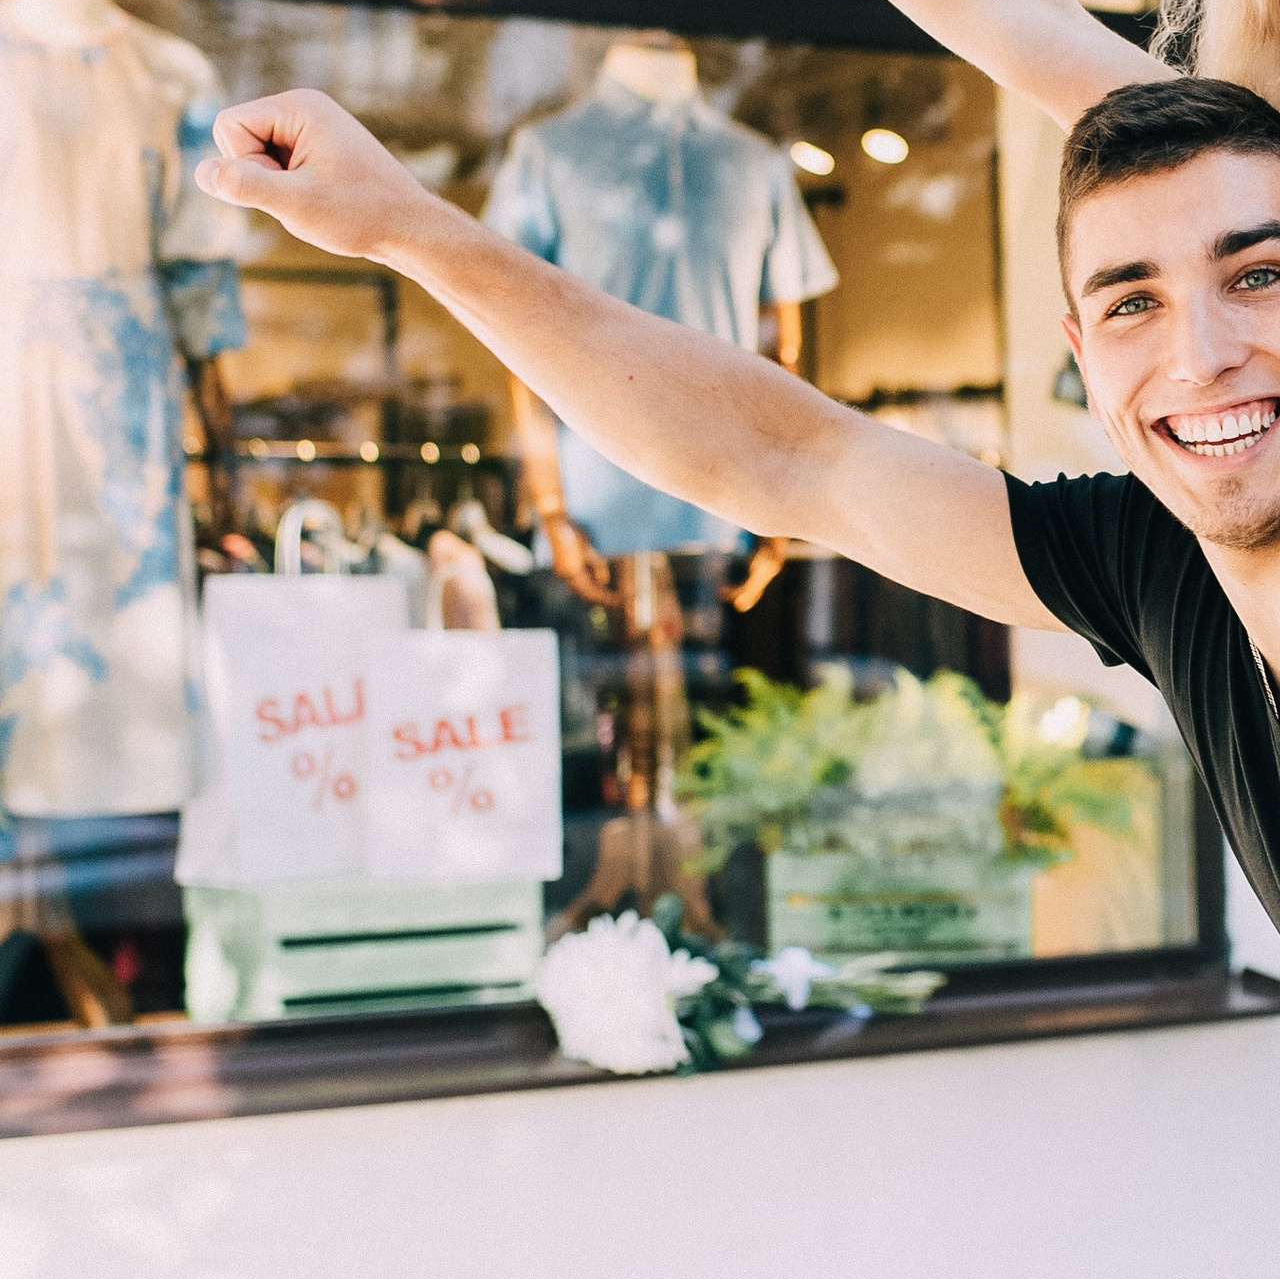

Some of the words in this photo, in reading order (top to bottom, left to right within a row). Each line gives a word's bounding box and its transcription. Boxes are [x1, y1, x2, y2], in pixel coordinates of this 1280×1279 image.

[391, 704, 534, 761] SALE
[291, 748, 357, 811] %
[428, 761, 496, 815] %
